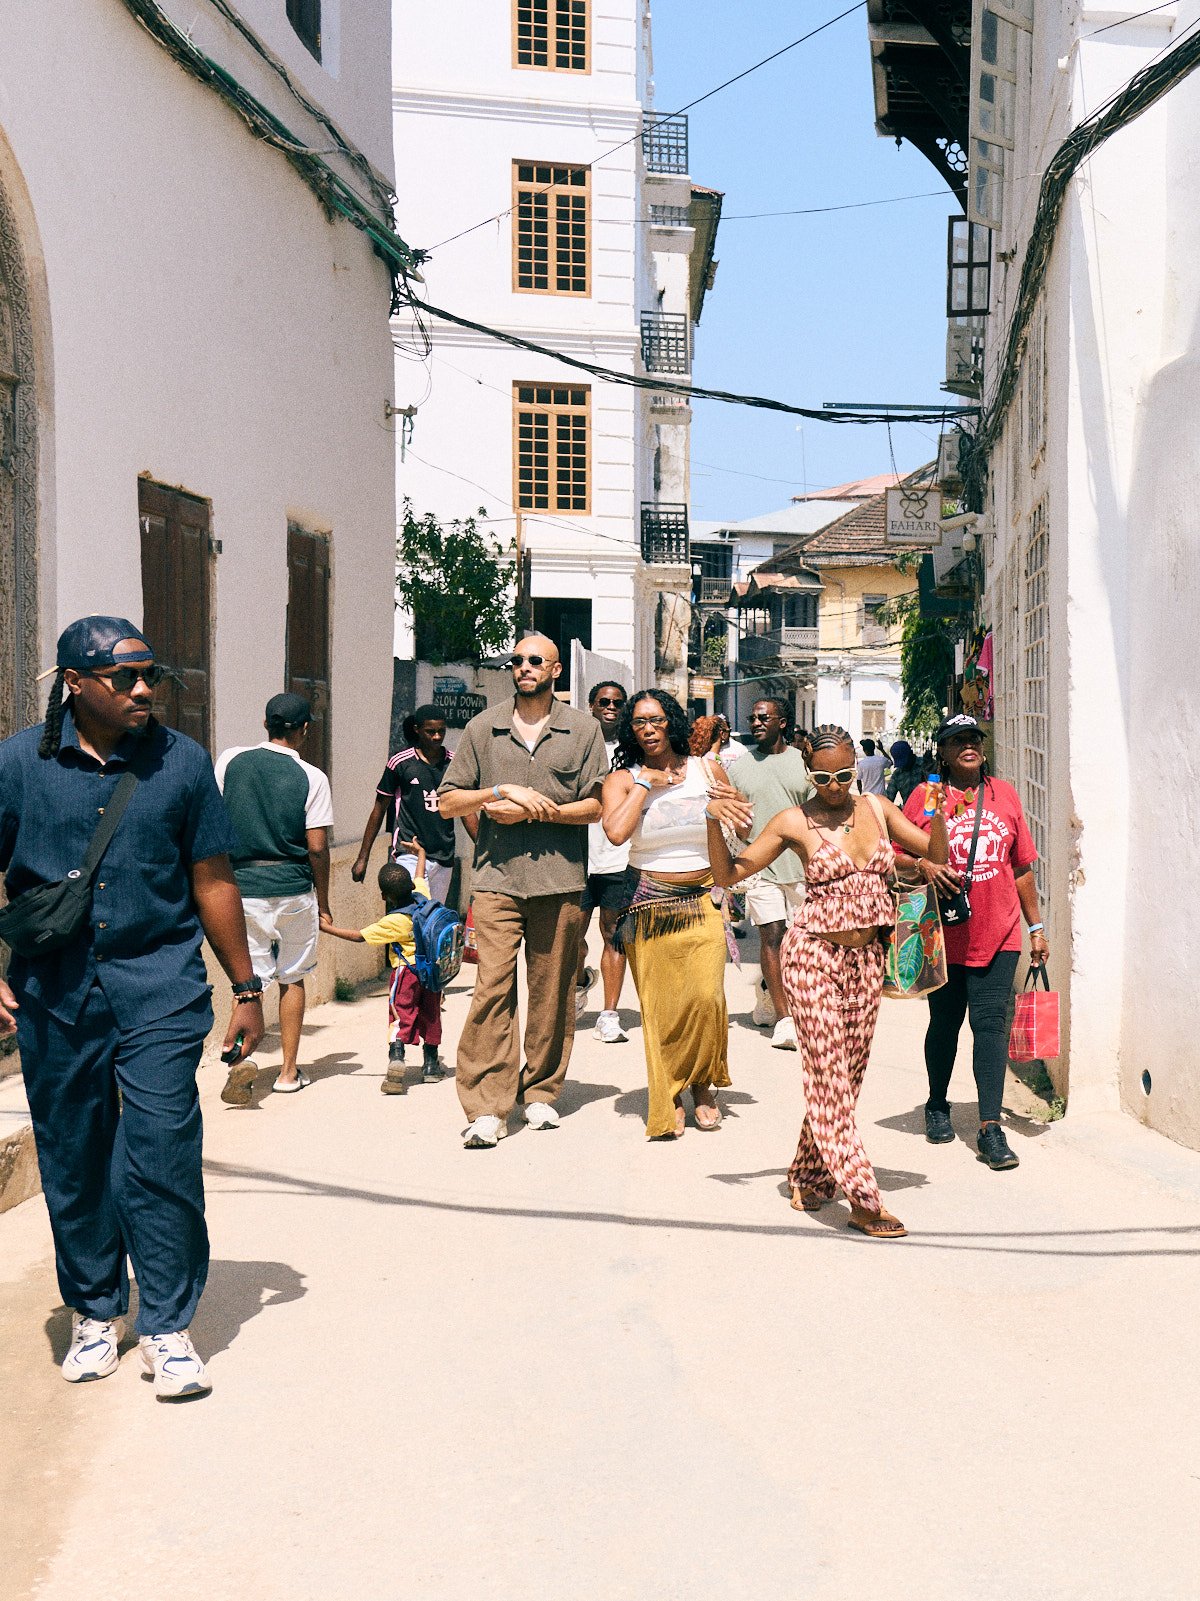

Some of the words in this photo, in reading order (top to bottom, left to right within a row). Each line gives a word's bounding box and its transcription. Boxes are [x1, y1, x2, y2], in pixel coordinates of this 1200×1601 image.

[891, 521, 937, 531] FAHARI
[434, 695, 458, 707] SLOW
[460, 695, 485, 708] DOWN
